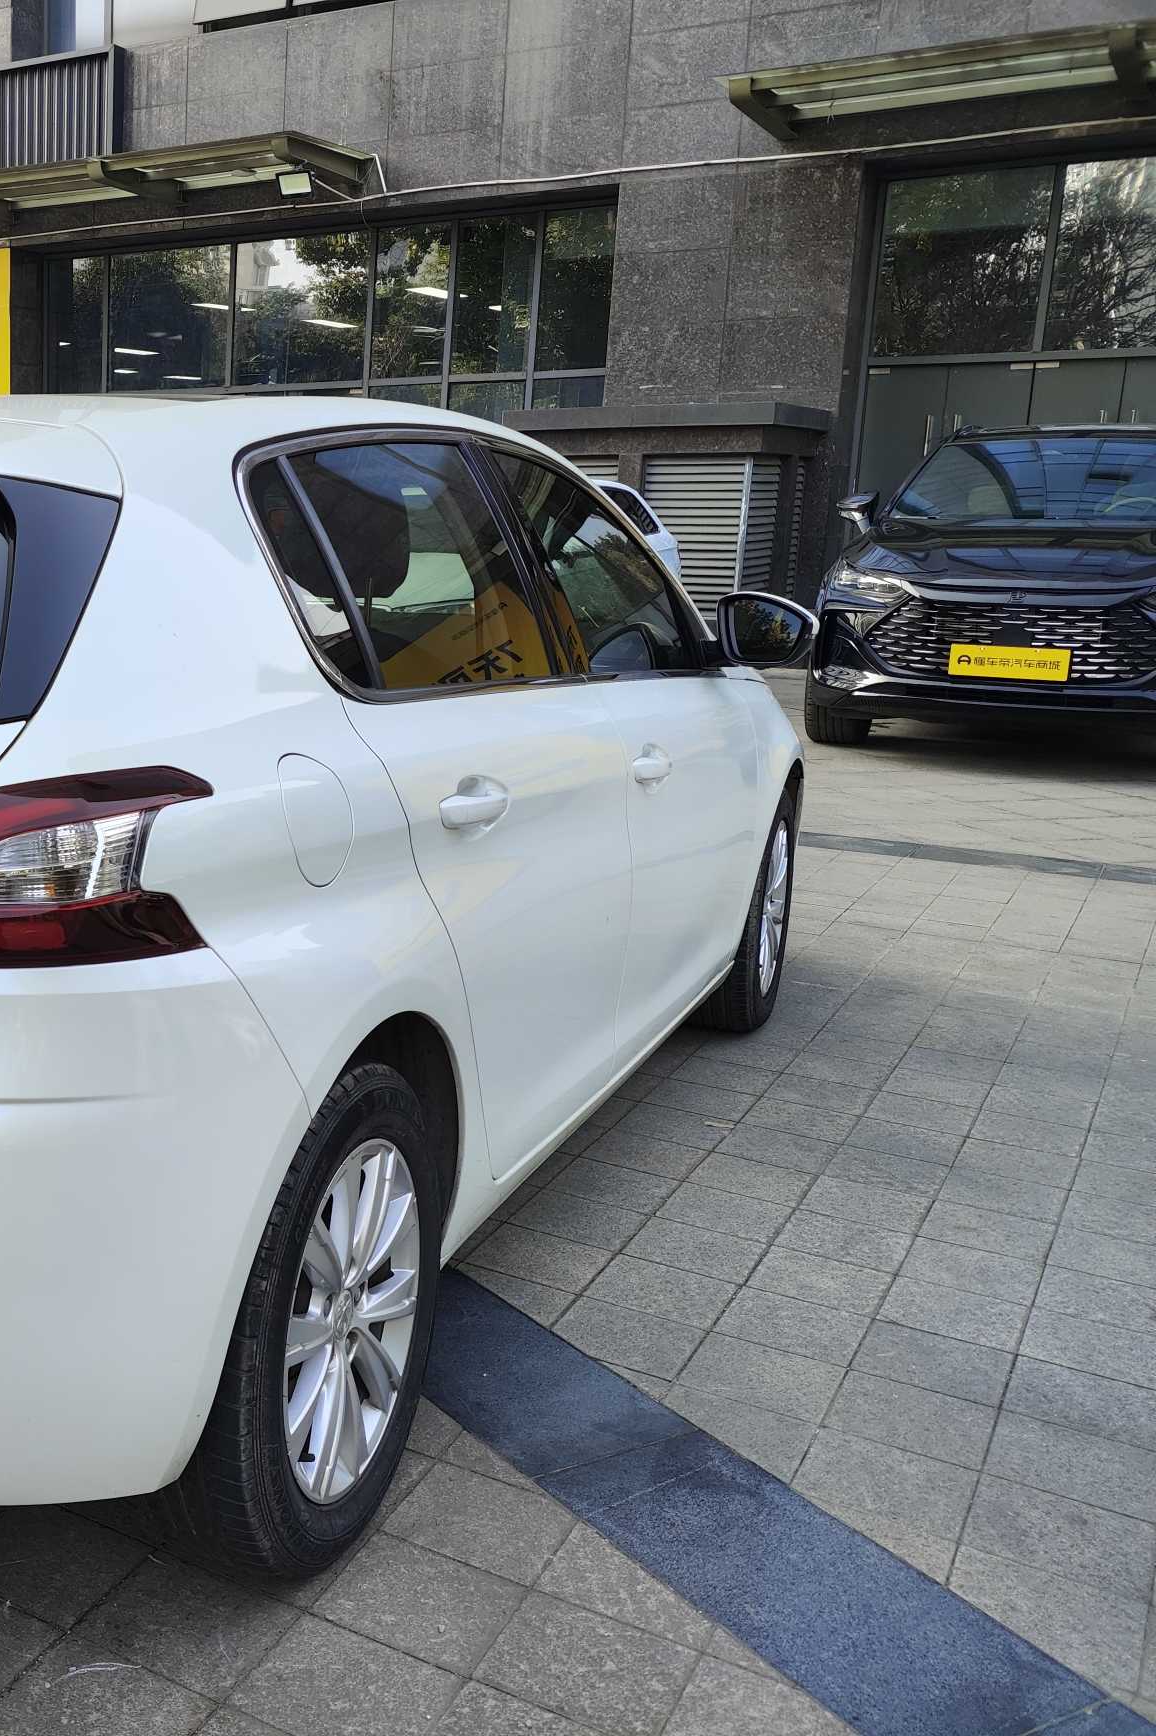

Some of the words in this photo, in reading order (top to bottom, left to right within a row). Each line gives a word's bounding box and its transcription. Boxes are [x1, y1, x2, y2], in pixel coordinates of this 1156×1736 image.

[973, 655, 1061, 671] 懂车帝汽车商城
